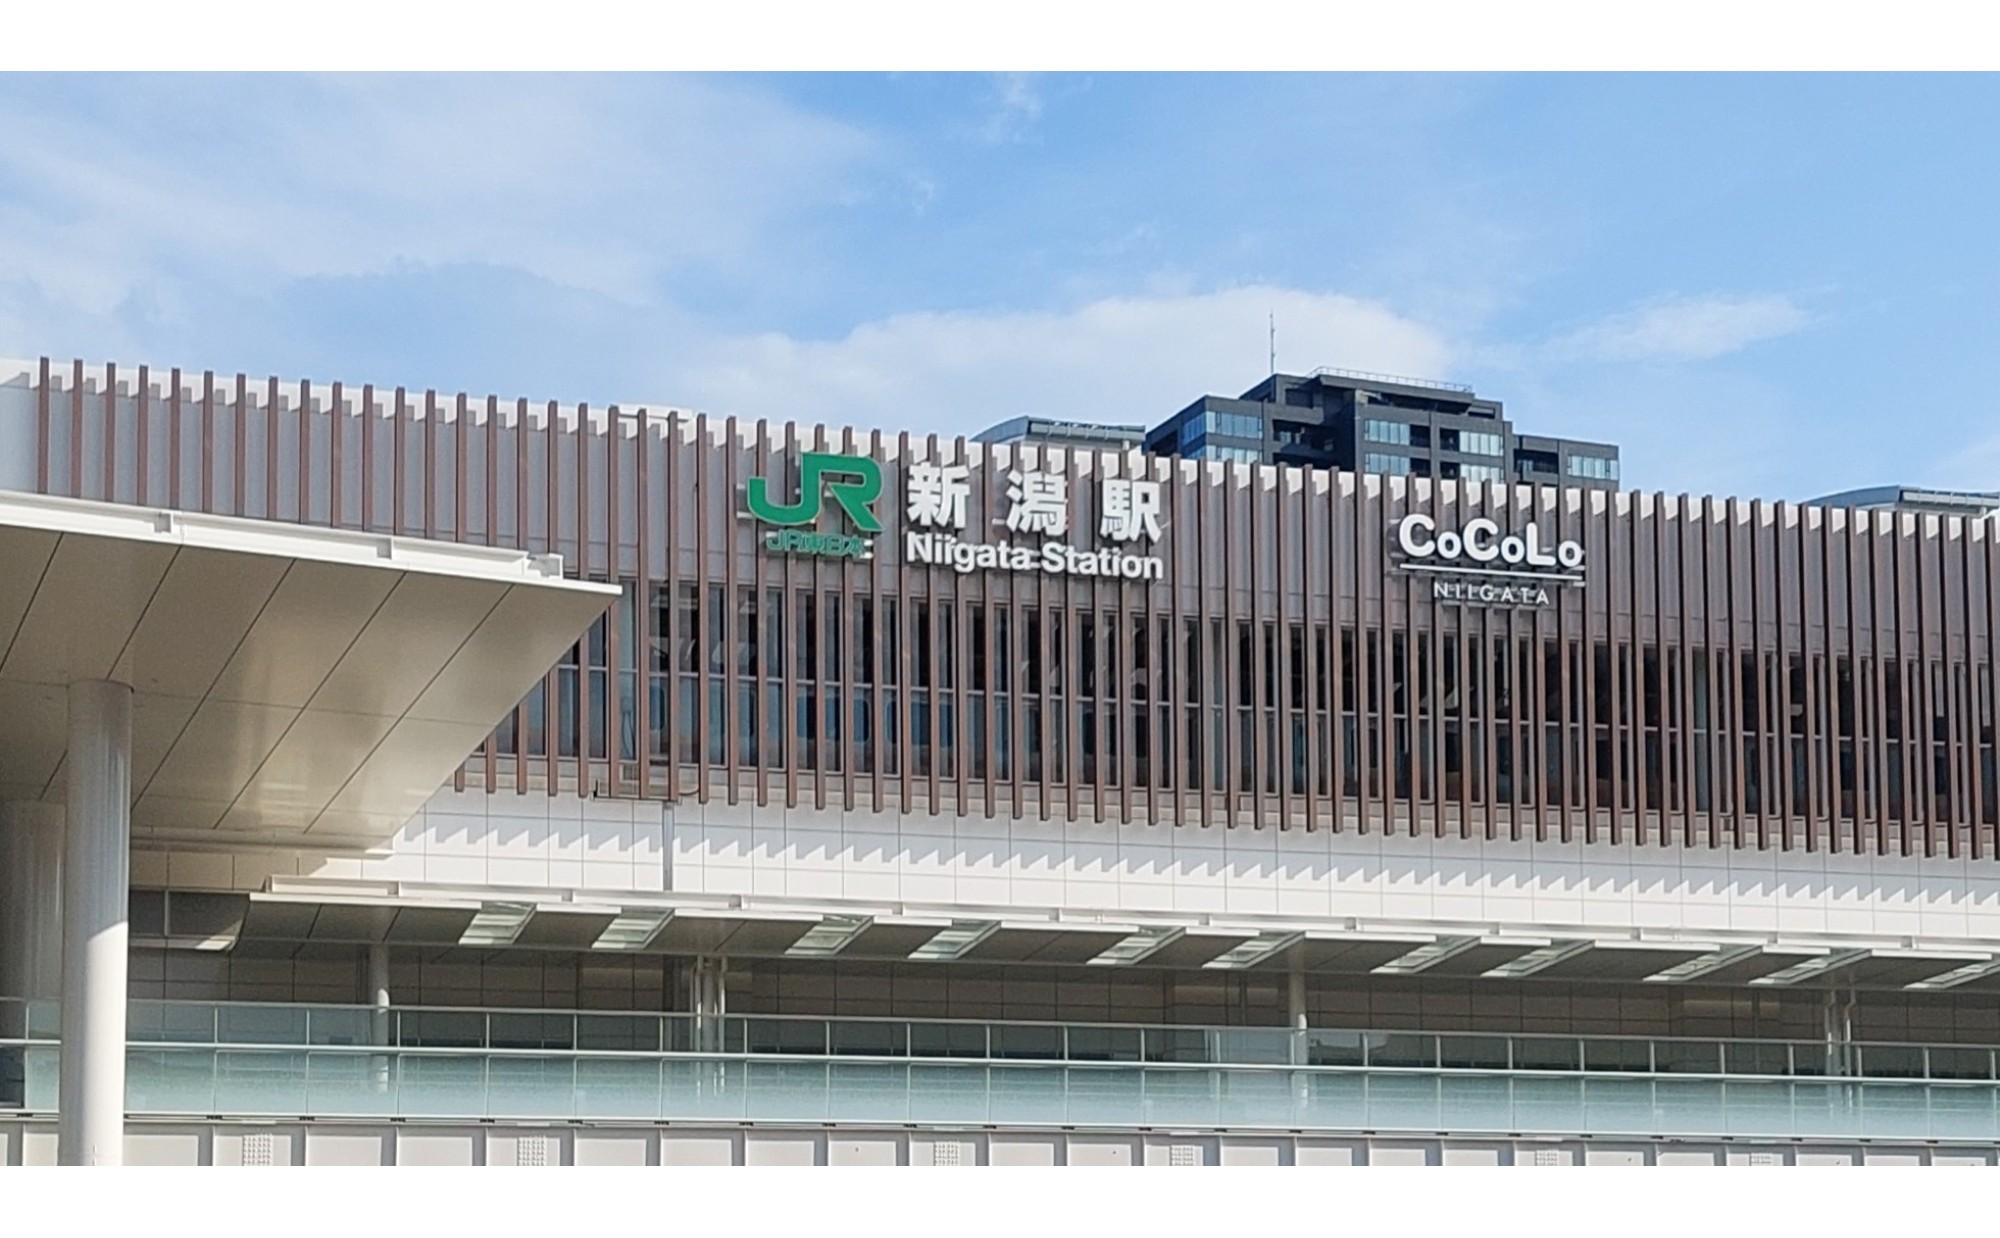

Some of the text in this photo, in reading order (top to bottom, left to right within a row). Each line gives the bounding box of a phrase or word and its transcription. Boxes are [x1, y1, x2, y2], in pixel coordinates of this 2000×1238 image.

[748, 453, 884, 531] JR
[907, 462, 1162, 542] 新潟駅
[907, 532, 1164, 579] Niigata Station
[1399, 513, 1583, 567] CoCoLo
[1433, 582, 1549, 605] NIIGATA
